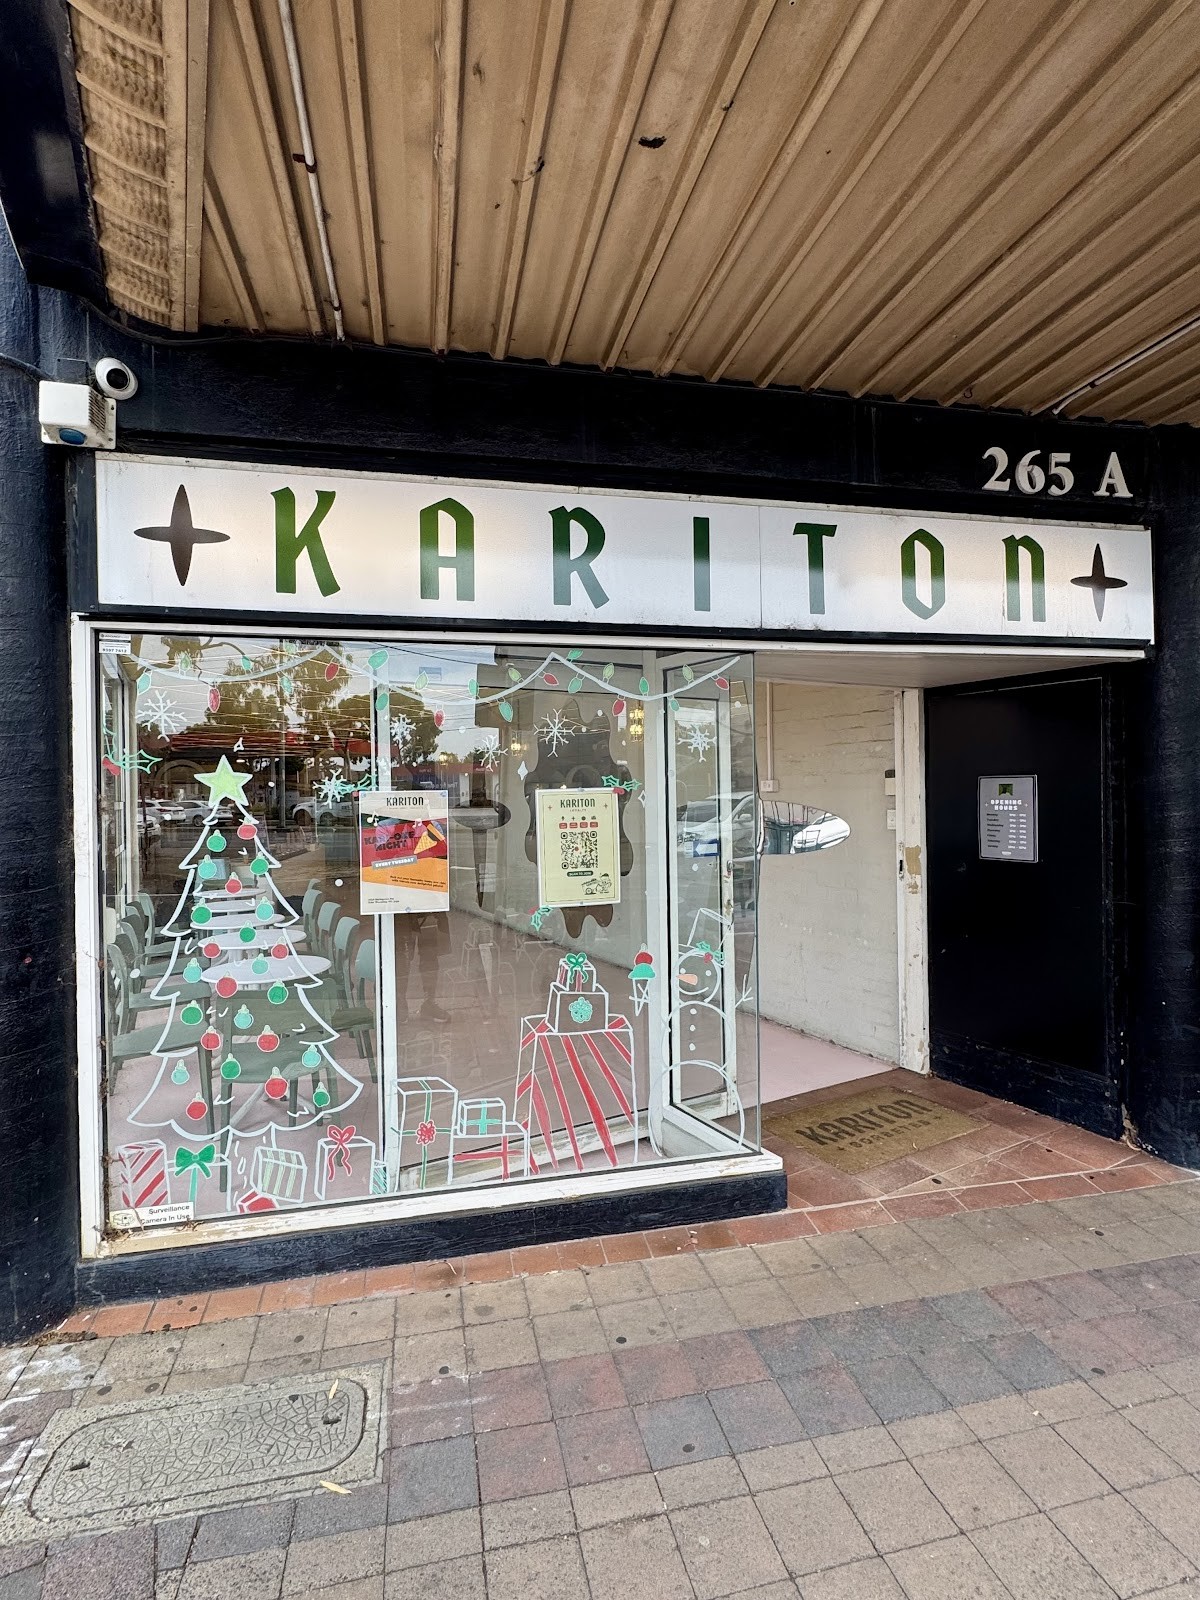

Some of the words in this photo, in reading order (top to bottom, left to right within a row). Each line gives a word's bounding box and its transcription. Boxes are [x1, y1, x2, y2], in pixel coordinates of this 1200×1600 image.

[982, 447, 1074, 496] 265
[1092, 452, 1133, 497] A
[270, 486, 1046, 622] KARITON
[386, 797, 424, 806] KARITON
[560, 798, 595, 808] KARITON
[795, 1099, 933, 1146] KARITON
[849, 1119, 931, 1148] SORBETES
[149, 1205, 190, 1214] Surveillance
[141, 1217, 167, 1225] Camera
